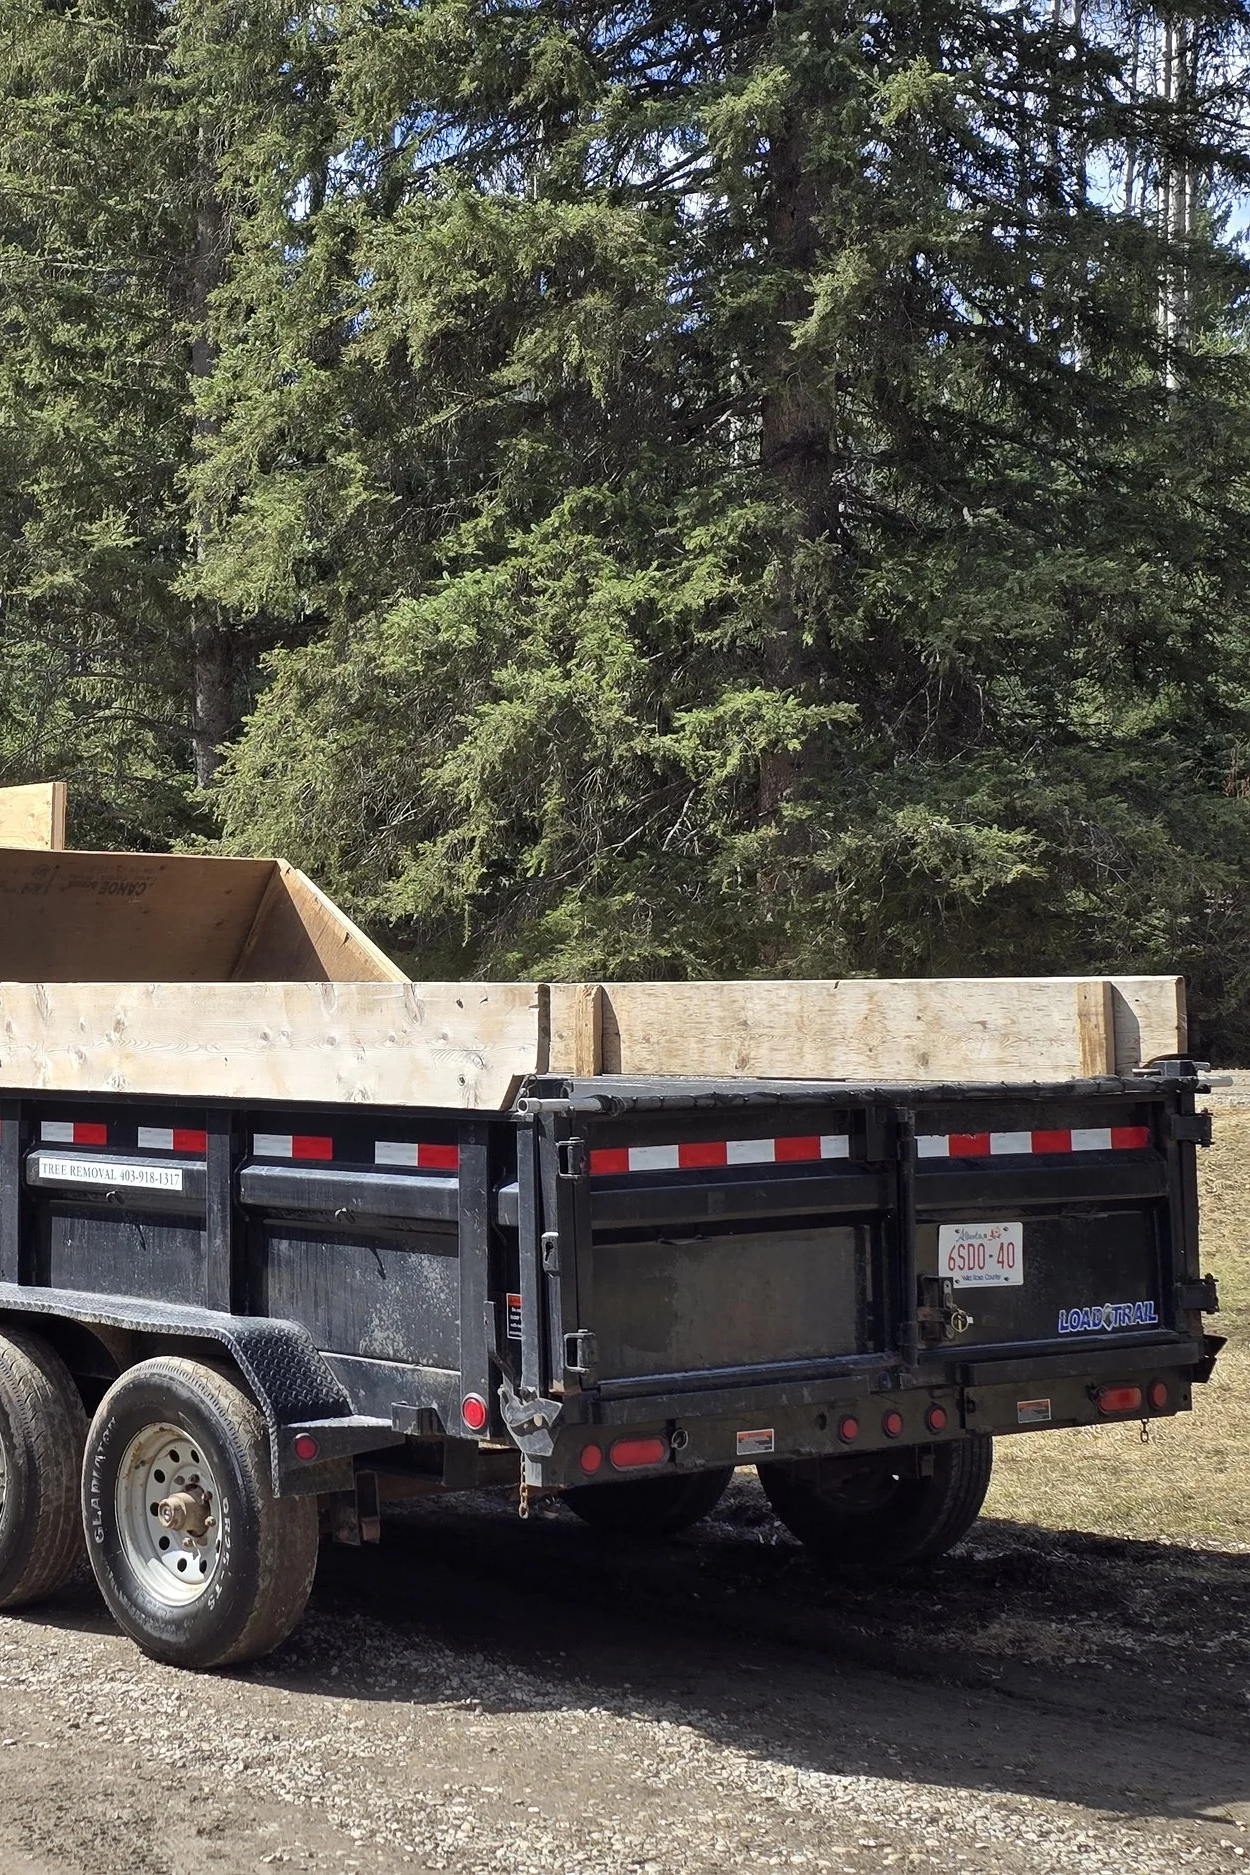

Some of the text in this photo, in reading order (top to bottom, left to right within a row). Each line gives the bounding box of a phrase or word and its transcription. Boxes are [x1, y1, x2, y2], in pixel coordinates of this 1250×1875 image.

[42, 1163, 180, 1186] TREE REMOVAL 403-918-1317
[1058, 1301, 1158, 1333] LOAD TRAIL
